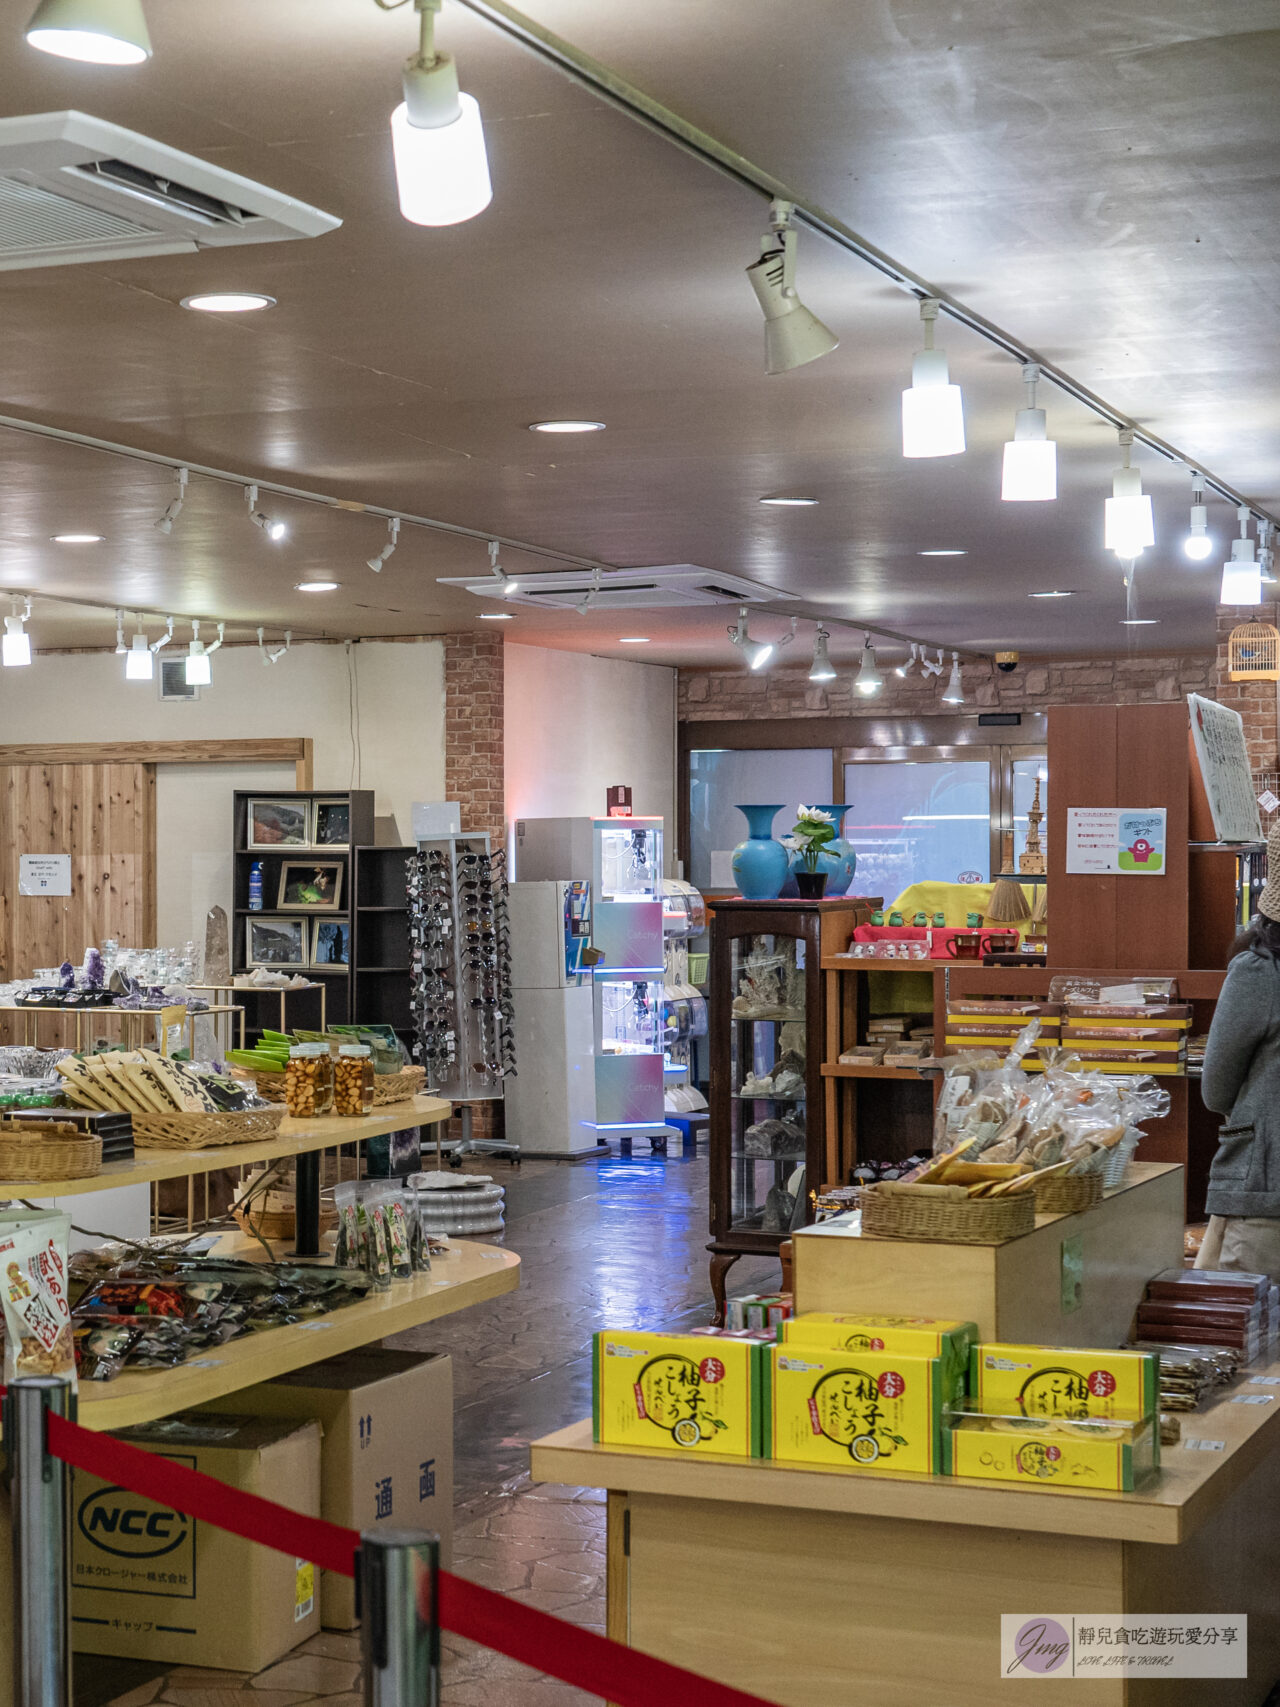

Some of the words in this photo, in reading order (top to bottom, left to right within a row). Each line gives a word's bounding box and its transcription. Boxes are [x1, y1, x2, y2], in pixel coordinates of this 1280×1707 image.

[678, 1364, 707, 1412] 柚子
[855, 1379, 885, 1427] 柚子
[88, 1506, 175, 1538] NCC
[76, 1564, 189, 1585] 日本クロージャー株式会社
[112, 1619, 153, 1632] キャップ
